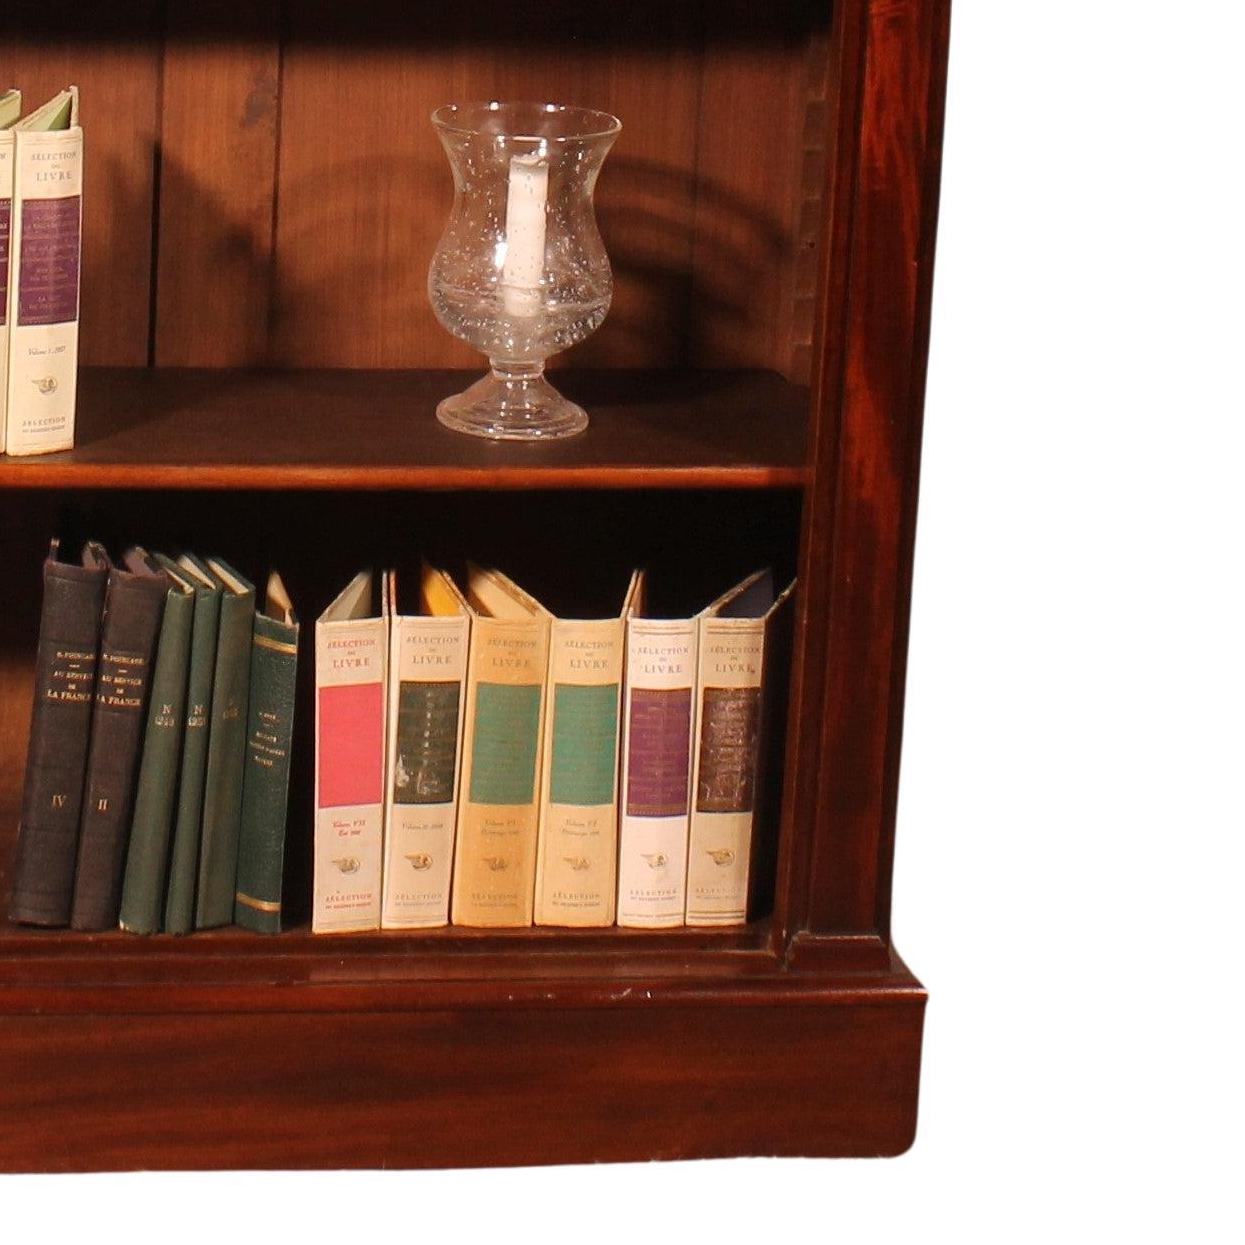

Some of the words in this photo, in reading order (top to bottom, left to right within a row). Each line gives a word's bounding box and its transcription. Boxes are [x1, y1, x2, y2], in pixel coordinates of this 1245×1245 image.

[36, 171, 73, 182] LIVRE
[333, 657, 370, 668] LIVRE
[412, 655, 452, 665] LIVRE
[492, 658, 531, 667] LIVRE
[570, 658, 610, 669] LIVRE
[644, 664, 683, 674] LIVRE
[715, 663, 752, 673] LIVRE
[108, 696, 141, 706] FRANCE
[51, 795, 66, 807] IV
[98, 798, 108, 810] II
